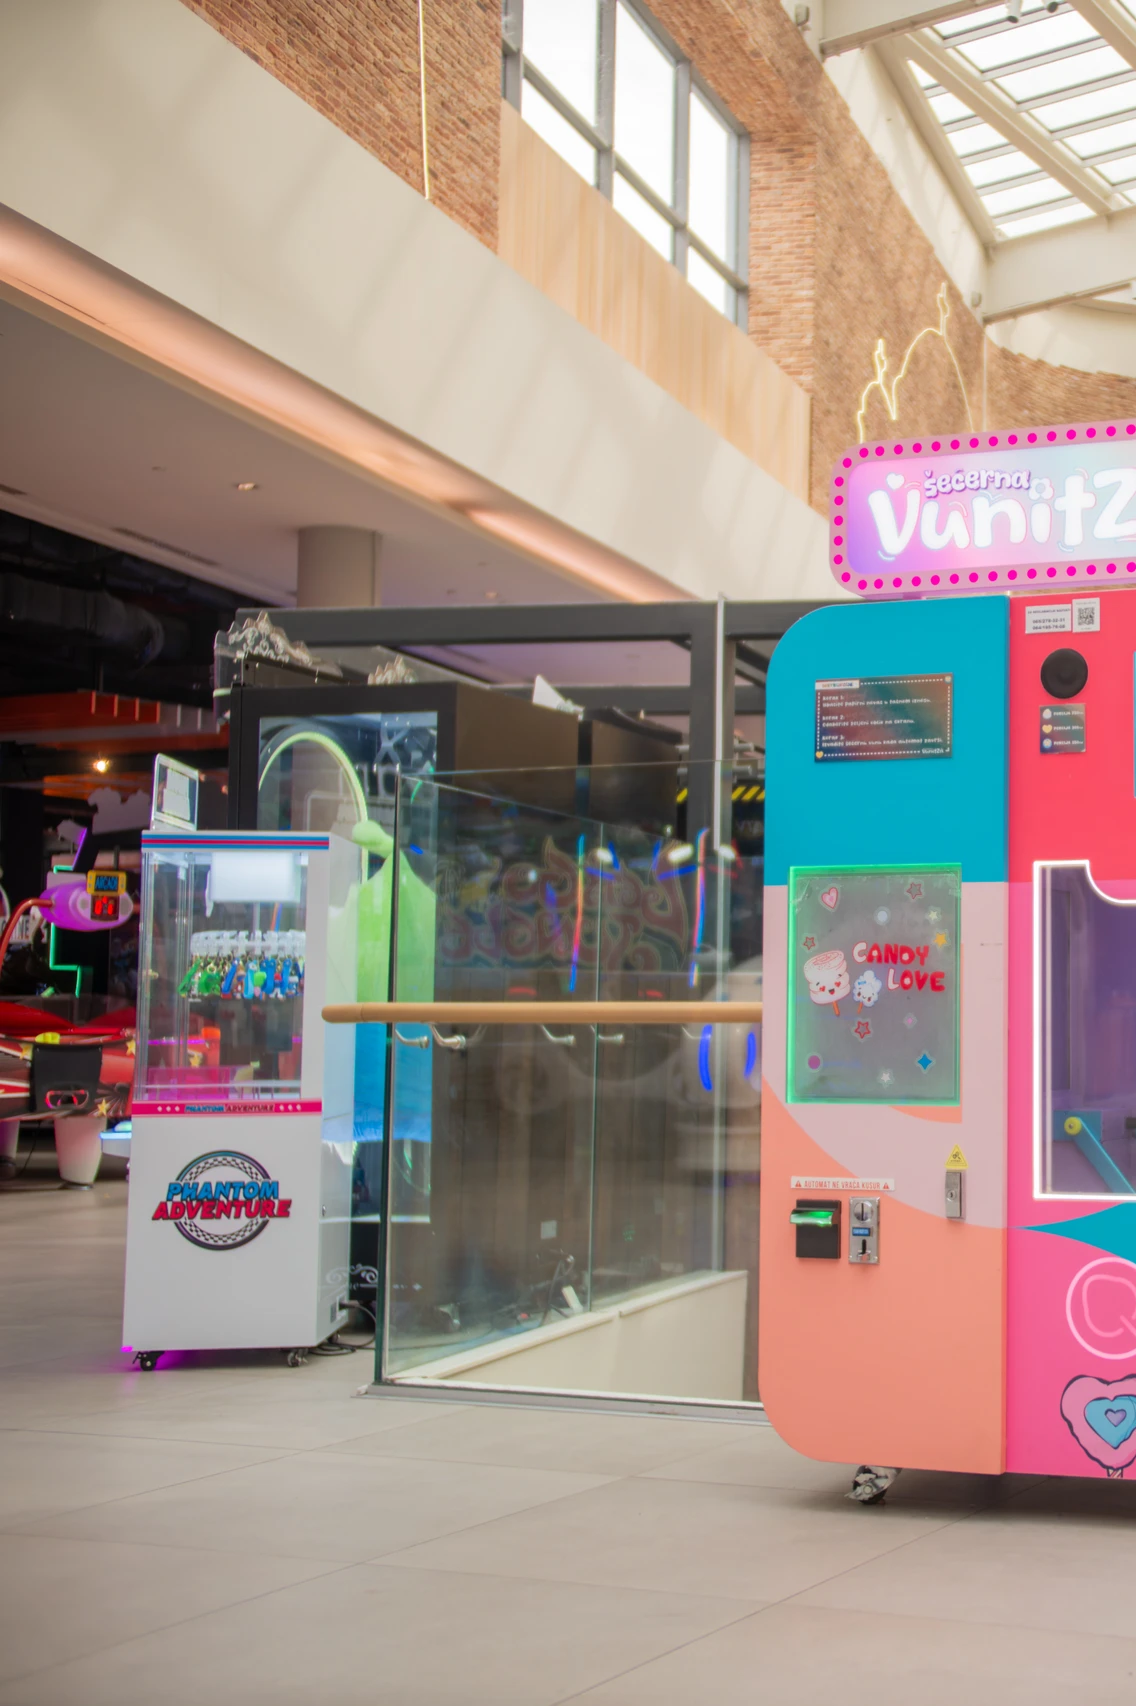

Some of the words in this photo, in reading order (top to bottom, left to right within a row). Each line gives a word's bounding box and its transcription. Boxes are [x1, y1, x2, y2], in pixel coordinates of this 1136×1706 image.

[853, 941, 929, 967] CANDY
[887, 968, 946, 993] LOVE
[166, 1180, 279, 1201] PHANTOM
[804, 1180, 830, 1188] AUTOMAT
[862, 1181, 880, 1190] KUSUR
[152, 1199, 292, 1220] ADVENTURE
